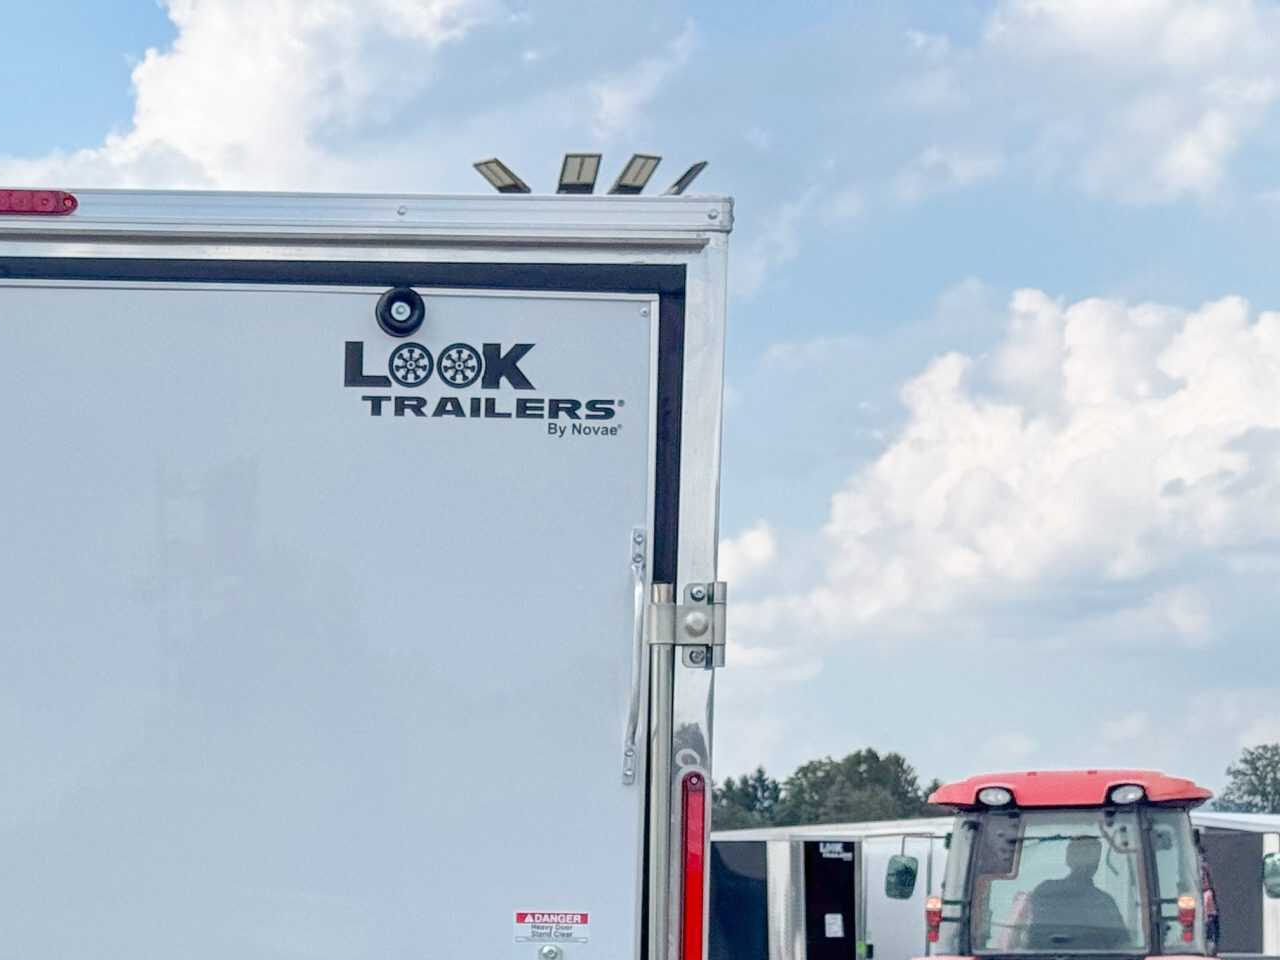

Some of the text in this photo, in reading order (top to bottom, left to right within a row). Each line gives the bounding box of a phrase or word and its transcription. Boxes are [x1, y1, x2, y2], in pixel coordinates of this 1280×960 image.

[344, 341, 536, 390] LOOK
[547, 423, 566, 438] By
[535, 914, 581, 923] DANGER
